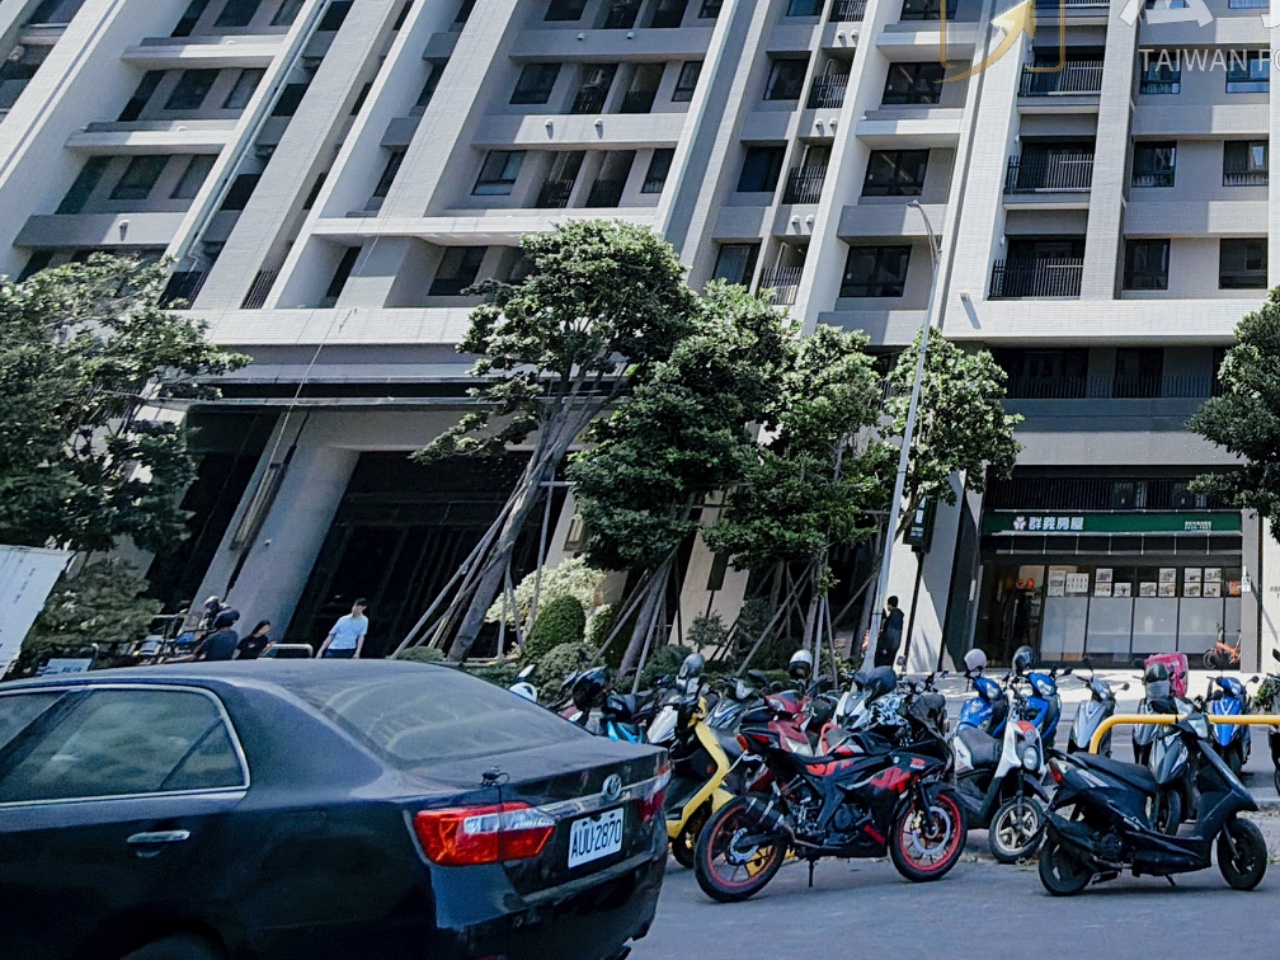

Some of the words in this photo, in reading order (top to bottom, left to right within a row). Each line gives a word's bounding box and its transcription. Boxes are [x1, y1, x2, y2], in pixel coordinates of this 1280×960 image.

[1028, 516, 1084, 531] 群義房屋
[571, 818, 622, 859] AUU-2870
